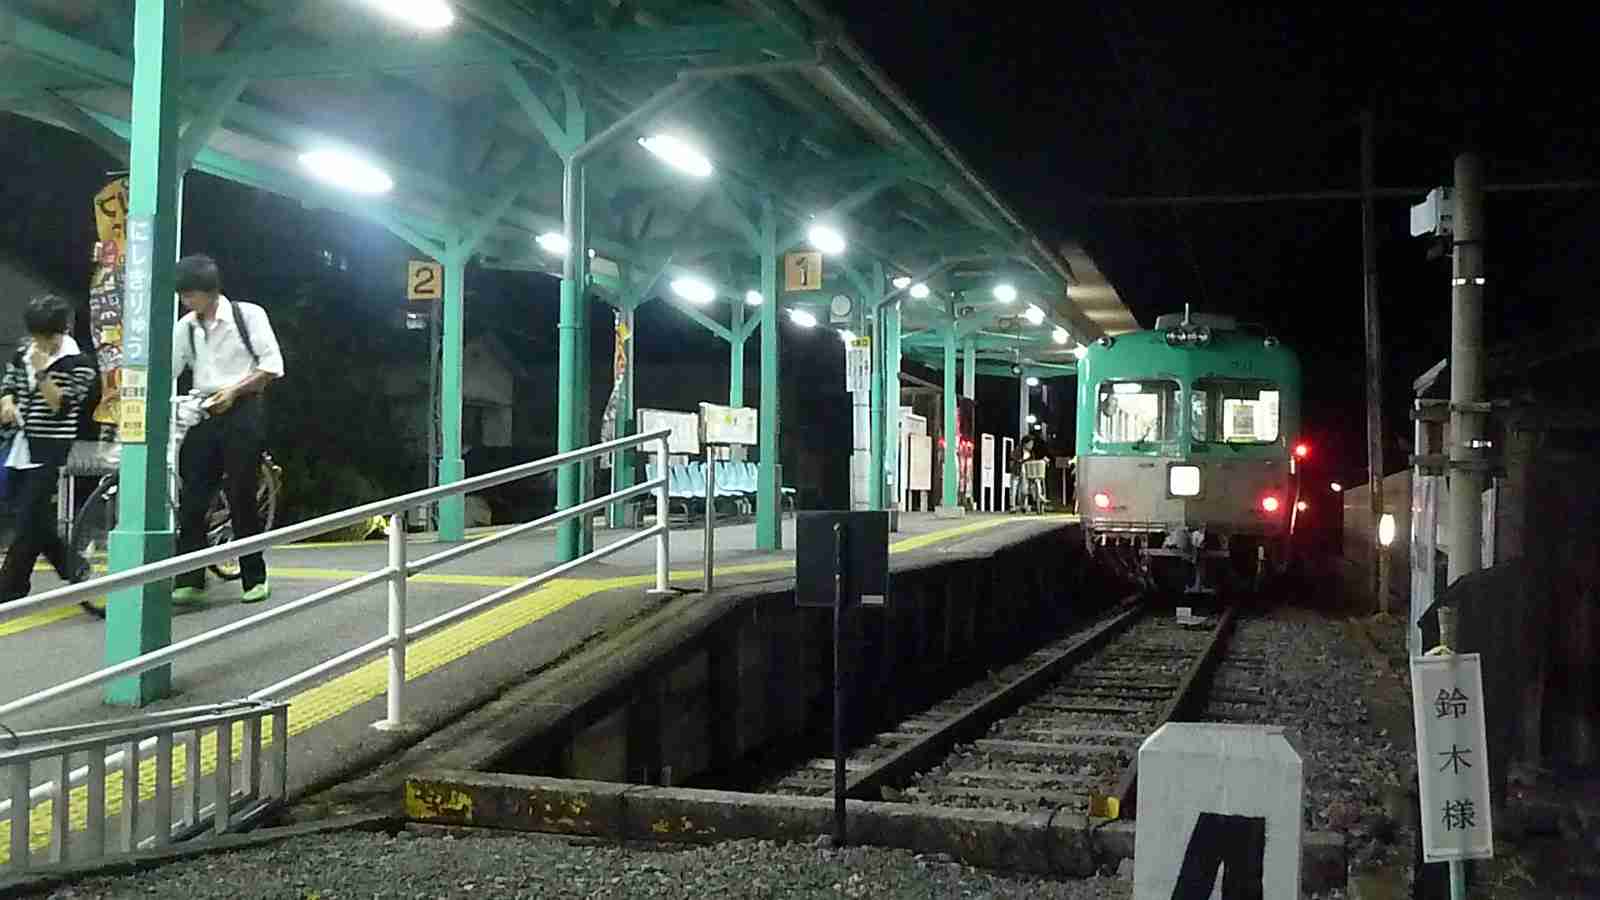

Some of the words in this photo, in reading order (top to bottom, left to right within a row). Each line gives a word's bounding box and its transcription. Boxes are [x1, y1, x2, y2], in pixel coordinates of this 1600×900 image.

[127, 219, 148, 359] にしきりゅう
[414, 266, 434, 294] 2
[795, 257, 808, 286] 1
[1434, 687, 1476, 831] 鈴木様
